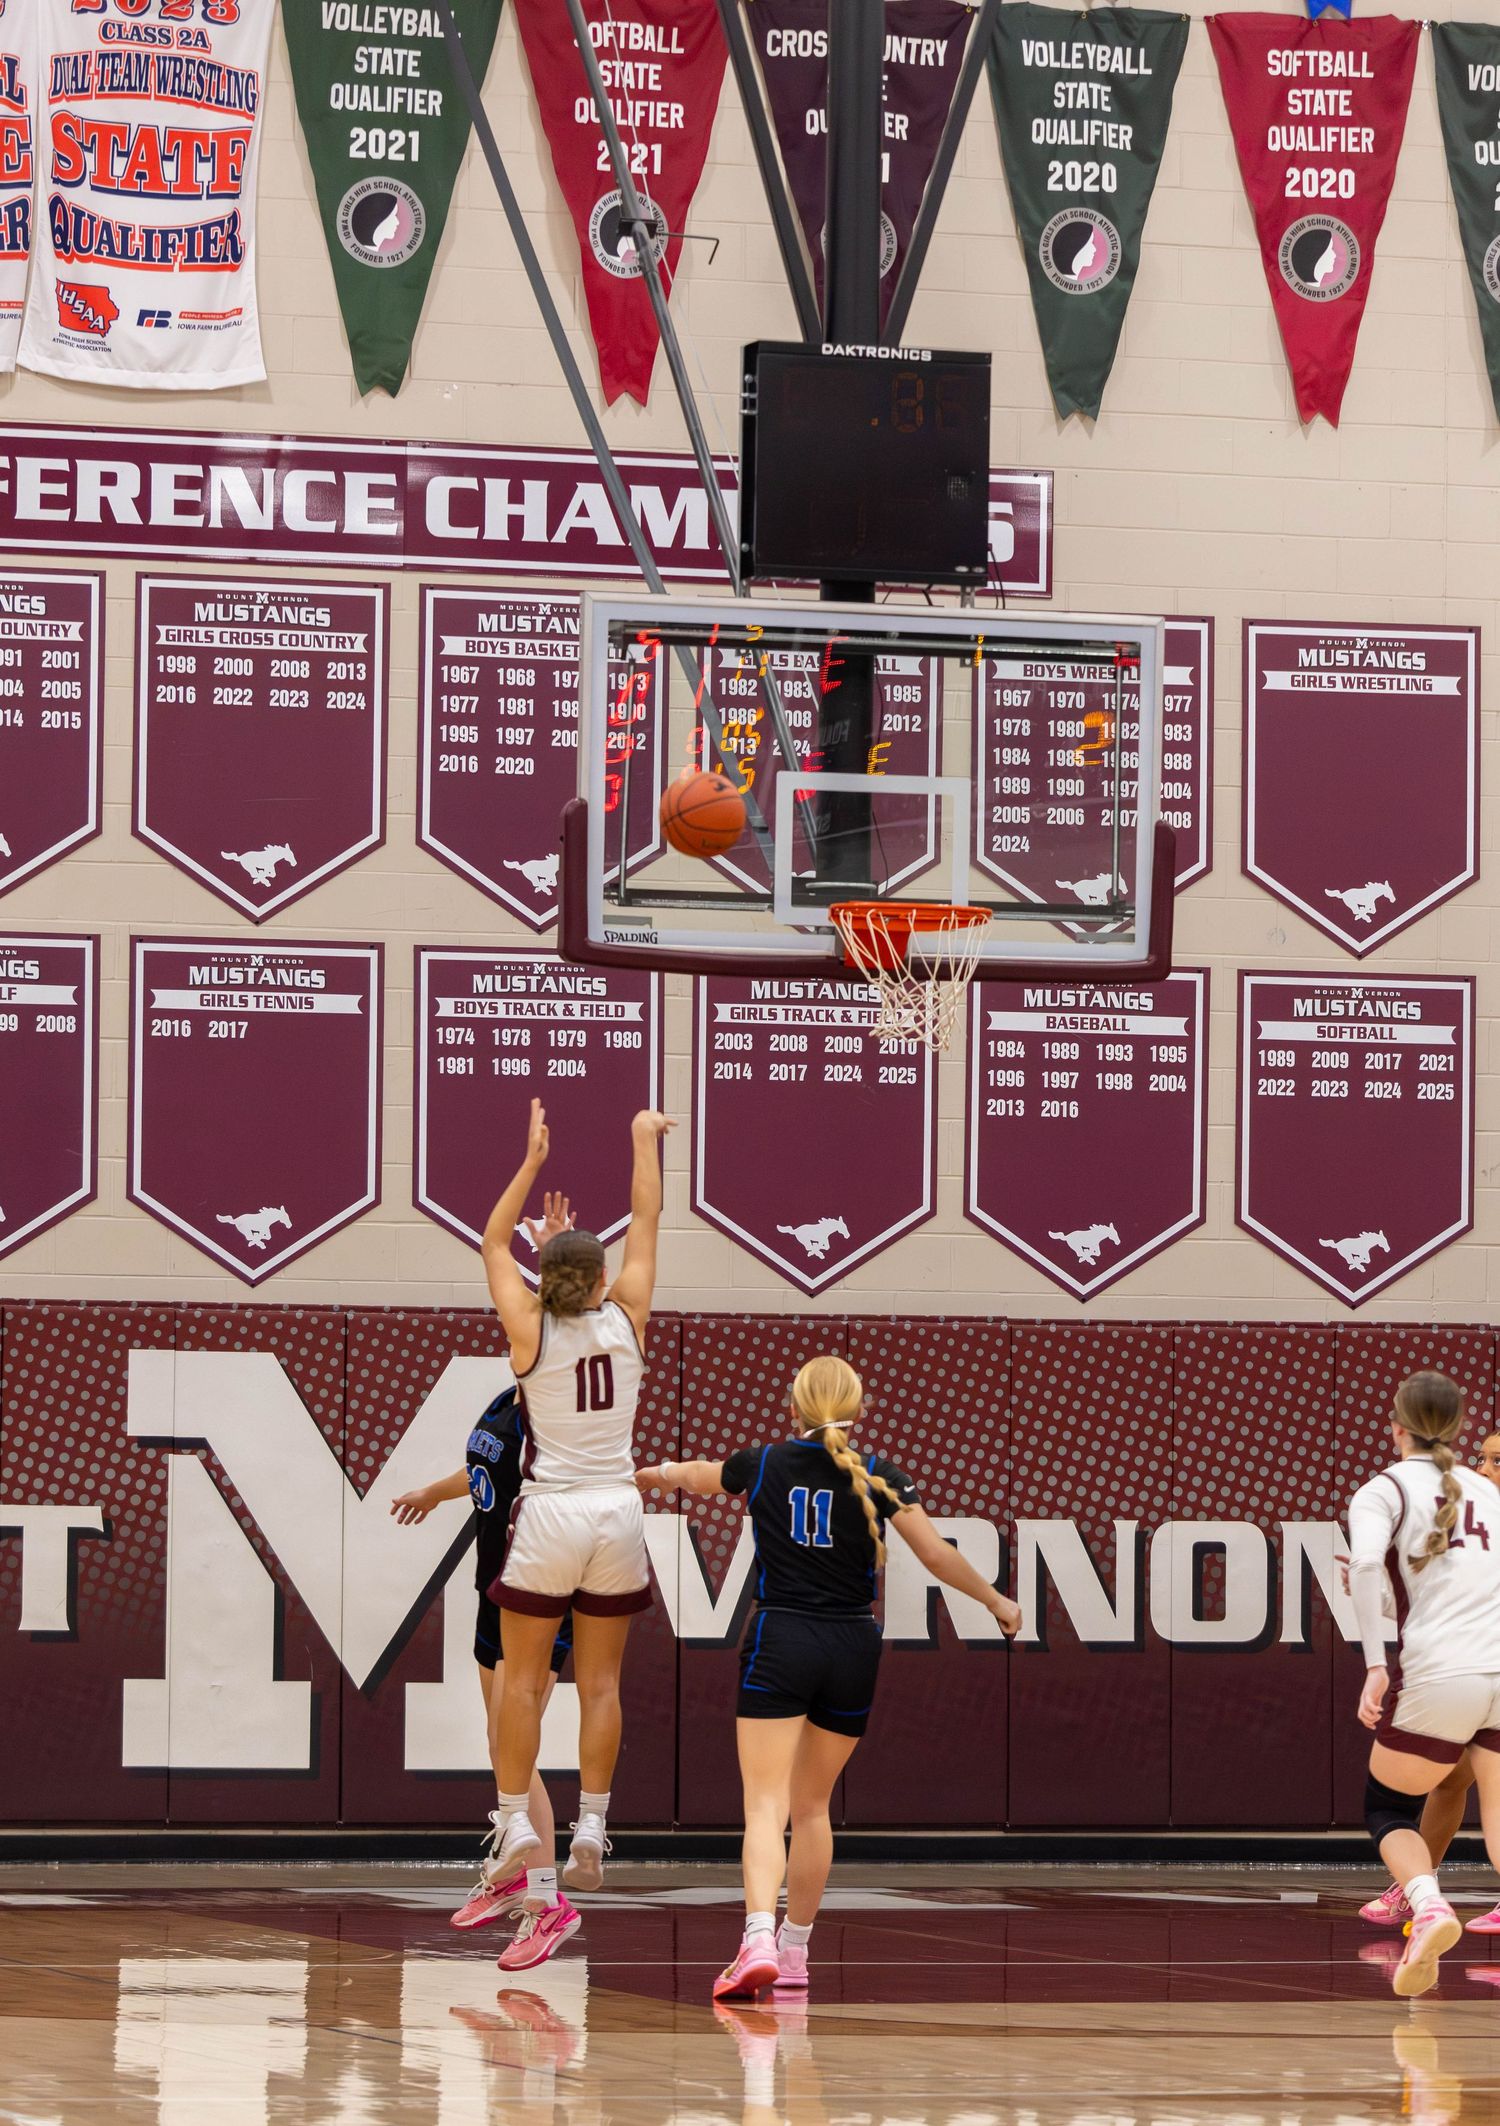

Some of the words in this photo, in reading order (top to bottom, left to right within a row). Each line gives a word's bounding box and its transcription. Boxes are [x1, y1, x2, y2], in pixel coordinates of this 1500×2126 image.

[321, 1, 462, 39] VOLLEYBAL
[100, 21, 173, 46] CLASS
[178, 28, 211, 52] 2A
[573, 21, 685, 54] OFTBALL
[766, 28, 828, 58] CROS
[354, 46, 421, 78] STATE
[1021, 39, 1153, 76] VOLLEYBALL
[1266, 49, 1375, 80] SOFTBALL
[50, 53, 92, 99] DUAL
[96, 51, 151, 97] TEAM
[155, 55, 258, 115] WRESTLING
[598, 59, 662, 91] STATE
[330, 82, 443, 117] QUALIFIER
[1053, 81, 1112, 113] STATE
[1287, 89, 1353, 117] STATE
[349, 126, 420, 162] 2021
[1031, 118, 1134, 151] QUALIFIER
[1267, 125, 1376, 154] QUALIFIER
[50, 110, 252, 200] STATE
[373, 181, 402, 195] SCHOOL
[1047, 160, 1118, 194] 2020
[1284, 167, 1356, 200] 2020
[354, 183, 372, 197] HIGH
[342, 195, 356, 217] GIRLS
[402, 191, 422, 225] ATHLETIC
[48, 192, 246, 270] QUALIFIER
[341, 219, 351, 240] IOWA
[406, 227, 422, 251] UNION
[350, 243, 384, 263] FOUNDED
[386, 251, 404, 263] 1927
[59, 284, 104, 329] IHSAA
[821, 343, 932, 362] DAKTRONICS
[0, 455, 399, 536] ERENCE
[217, 593, 254, 601] MOUNT
[270, 595, 309, 603] VERNON
[500, 604, 536, 612] MOUNT
[194, 602, 331, 627] MUSTANGS
[478, 613, 579, 635] MUSTAN
[0, 622, 72, 638] OUNTRY
[165, 629, 214, 644] GIRLS
[219, 631, 274, 646] CROSS
[278, 633, 358, 650] COUNTRY
[465, 639, 510, 655] BOYS
[41, 650, 80, 670] 2001
[157, 655, 196, 674] 1998
[213, 657, 253, 676] 2000
[270, 660, 310, 679] 2008
[326, 662, 366, 680] 2013
[1298, 648, 1426, 671] MUSTANGS
[441, 666, 479, 684] 1967
[497, 668, 535, 686] 1968
[1023, 664, 1066, 679] BOYS
[1290, 674, 1337, 689] GIRLS
[1341, 676, 1433, 692] WRESTLING
[41, 680, 82, 699] 2005
[156, 685, 196, 704] 2016
[213, 688, 253, 706] 2022
[269, 690, 309, 708] 2023
[326, 691, 366, 710] 2024
[719, 678, 757, 696] 1982
[884, 685, 921, 703] 1985
[994, 690, 1031, 707] 1967
[1048, 691, 1085, 709] 1970
[440, 695, 479, 713] 1977
[497, 697, 535, 716] 1981
[40, 710, 82, 729] 2015
[719, 708, 757, 725] 1986
[883, 714, 922, 733] 2012
[993, 718, 1031, 736] 1978
[1047, 720, 1085, 738] 1980
[440, 725, 478, 743] 1995
[496, 727, 534, 745] 1997
[439, 754, 478, 773] 2016
[495, 757, 534, 775] 2020
[993, 748, 1031, 766] 1984
[1047, 750, 1085, 767] 1985
[993, 777, 1031, 795] 1989
[1047, 779, 1085, 797] 1990
[992, 806, 1030, 824] 2005
[1046, 808, 1085, 826] 2006
[992, 835, 1030, 853] 2024
[603, 930, 658, 945] SPALDING
[211, 956, 248, 964] MOUNT
[189, 965, 326, 989] MUSTANGS
[472, 974, 607, 997] MUSTANGS
[199, 993, 249, 1008] GIRLS
[254, 995, 315, 1010] TENNIS
[751, 980, 883, 1004] MUSTANGS
[1023, 988, 1154, 1012] MUSTANGS
[454, 1001, 498, 1015] BOYS
[503, 1002, 557, 1017] TRACK
[562, 1004, 576, 1017] &
[580, 1004, 626, 1018] FIELD
[730, 1006, 778, 1021] GIRLS
[782, 1008, 836, 1023] TRACK
[840, 1010, 853, 1024] &
[1293, 998, 1422, 1021] MUSTANGS
[35, 1014, 77, 1033] 2008
[151, 1019, 192, 1038] 2016
[208, 1020, 249, 1039] 2017
[1046, 1015, 1130, 1032] BASEBALL
[1316, 1025, 1397, 1041] SOFTBALL
[436, 1027, 475, 1045] 1974
[492, 1028, 531, 1047] 1978
[548, 1030, 587, 1048] 1979
[603, 1031, 642, 1049] 1980
[714, 1032, 753, 1051] 2003
[769, 1034, 808, 1053] 2008
[824, 1035, 863, 1054] 2009
[879, 1037, 918, 1056] 2010
[987, 1040, 1026, 1059] 1984
[1042, 1042, 1080, 1060] 1989
[1096, 1043, 1134, 1062] 1993
[1150, 1045, 1188, 1063] 1995
[1258, 1049, 1296, 1068] 1989
[1311, 1051, 1349, 1069] 2009
[1364, 1052, 1402, 1071] 2017
[1418, 1054, 1455, 1072] 2021
[437, 1057, 474, 1075] 1981
[492, 1058, 531, 1076] 1996
[547, 1059, 587, 1077] 2004
[713, 1061, 752, 1080] 2014
[768, 1063, 808, 1082] 2017
[823, 1064, 863, 1083] 2024
[878, 1066, 917, 1085] 2025
[987, 1069, 1025, 1088] 1996
[1041, 1071, 1079, 1089] 1997
[1095, 1072, 1133, 1091] 1998
[1149, 1074, 1187, 1093] 2004
[1257, 1078, 1296, 1097] 2022
[1311, 1080, 1349, 1098] 2023
[1364, 1081, 1402, 1099] 2024
[1417, 1082, 1455, 1101] 2025
[986, 1098, 1025, 1117] 2013
[1040, 1100, 1079, 1118] 2016
[575, 1353, 615, 1413] 10
[787, 1486, 834, 1549] 11
[121, 1349, 582, 1771] M
[643, 1513, 1398, 1645] VRNON
